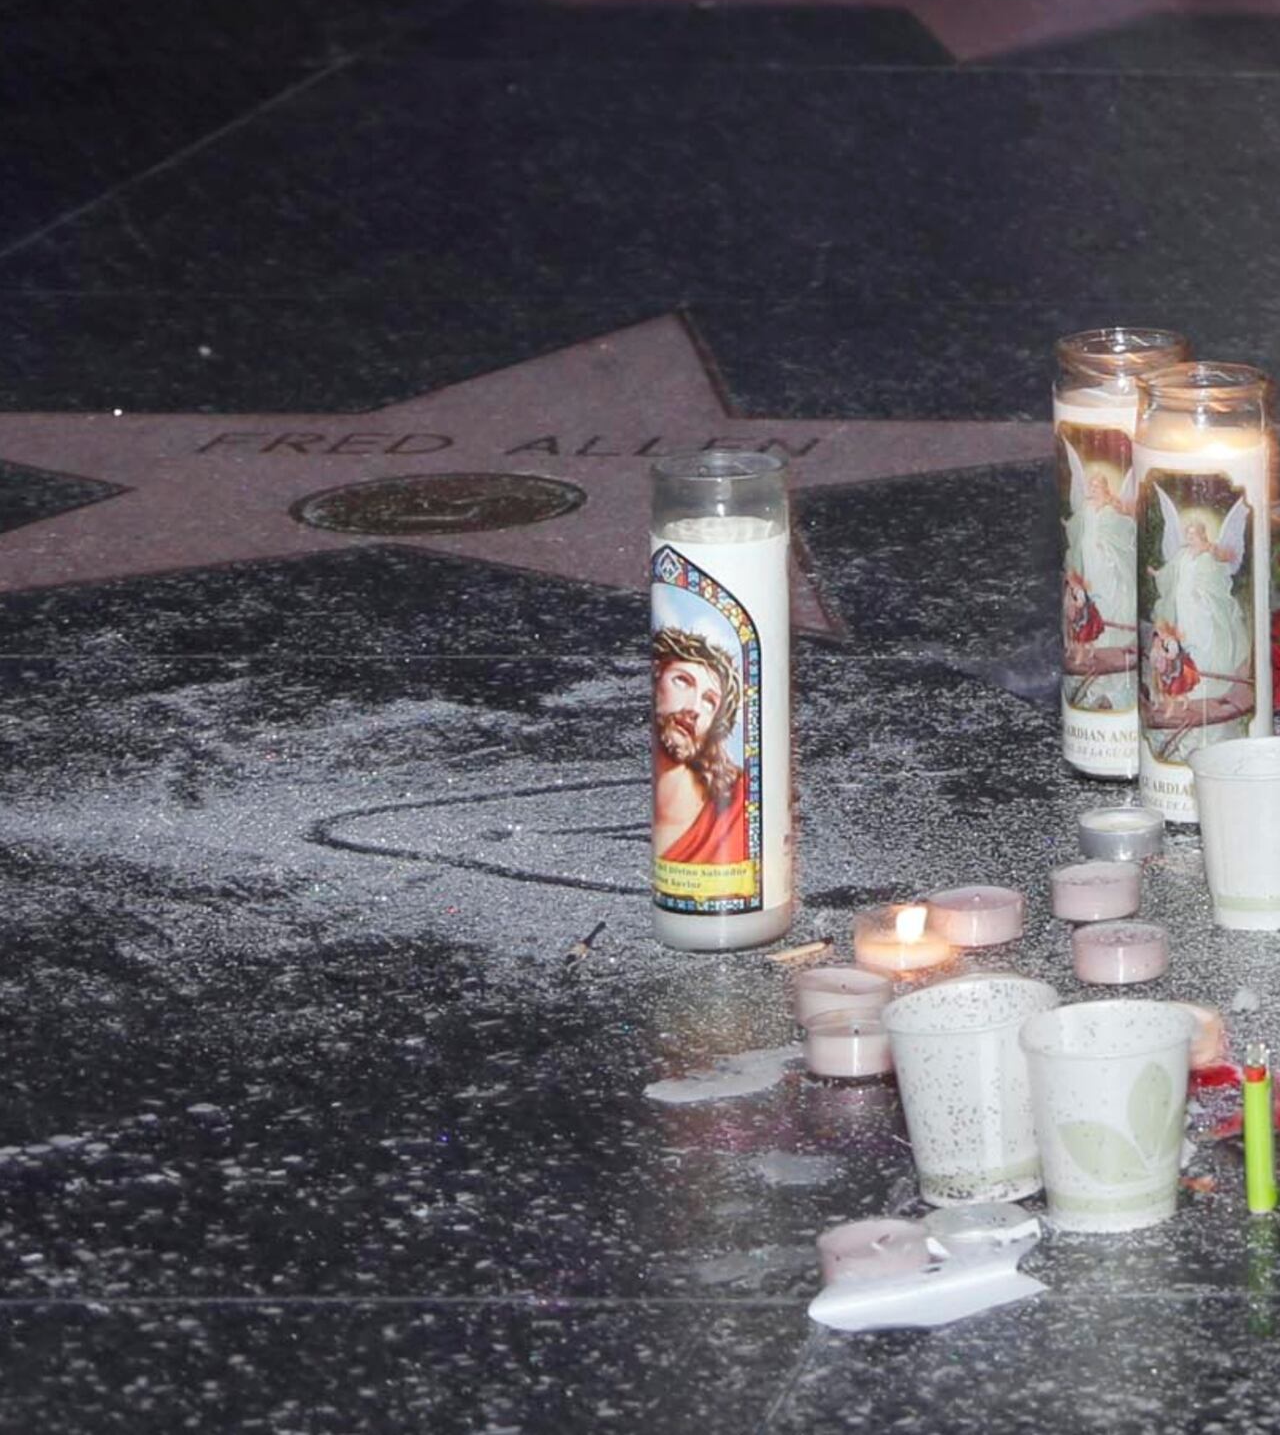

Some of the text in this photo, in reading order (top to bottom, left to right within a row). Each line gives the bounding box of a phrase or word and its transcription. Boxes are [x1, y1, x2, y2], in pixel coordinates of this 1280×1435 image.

[197, 431, 819, 459] FRED ALLEN
[1111, 729, 1138, 743] ANG
